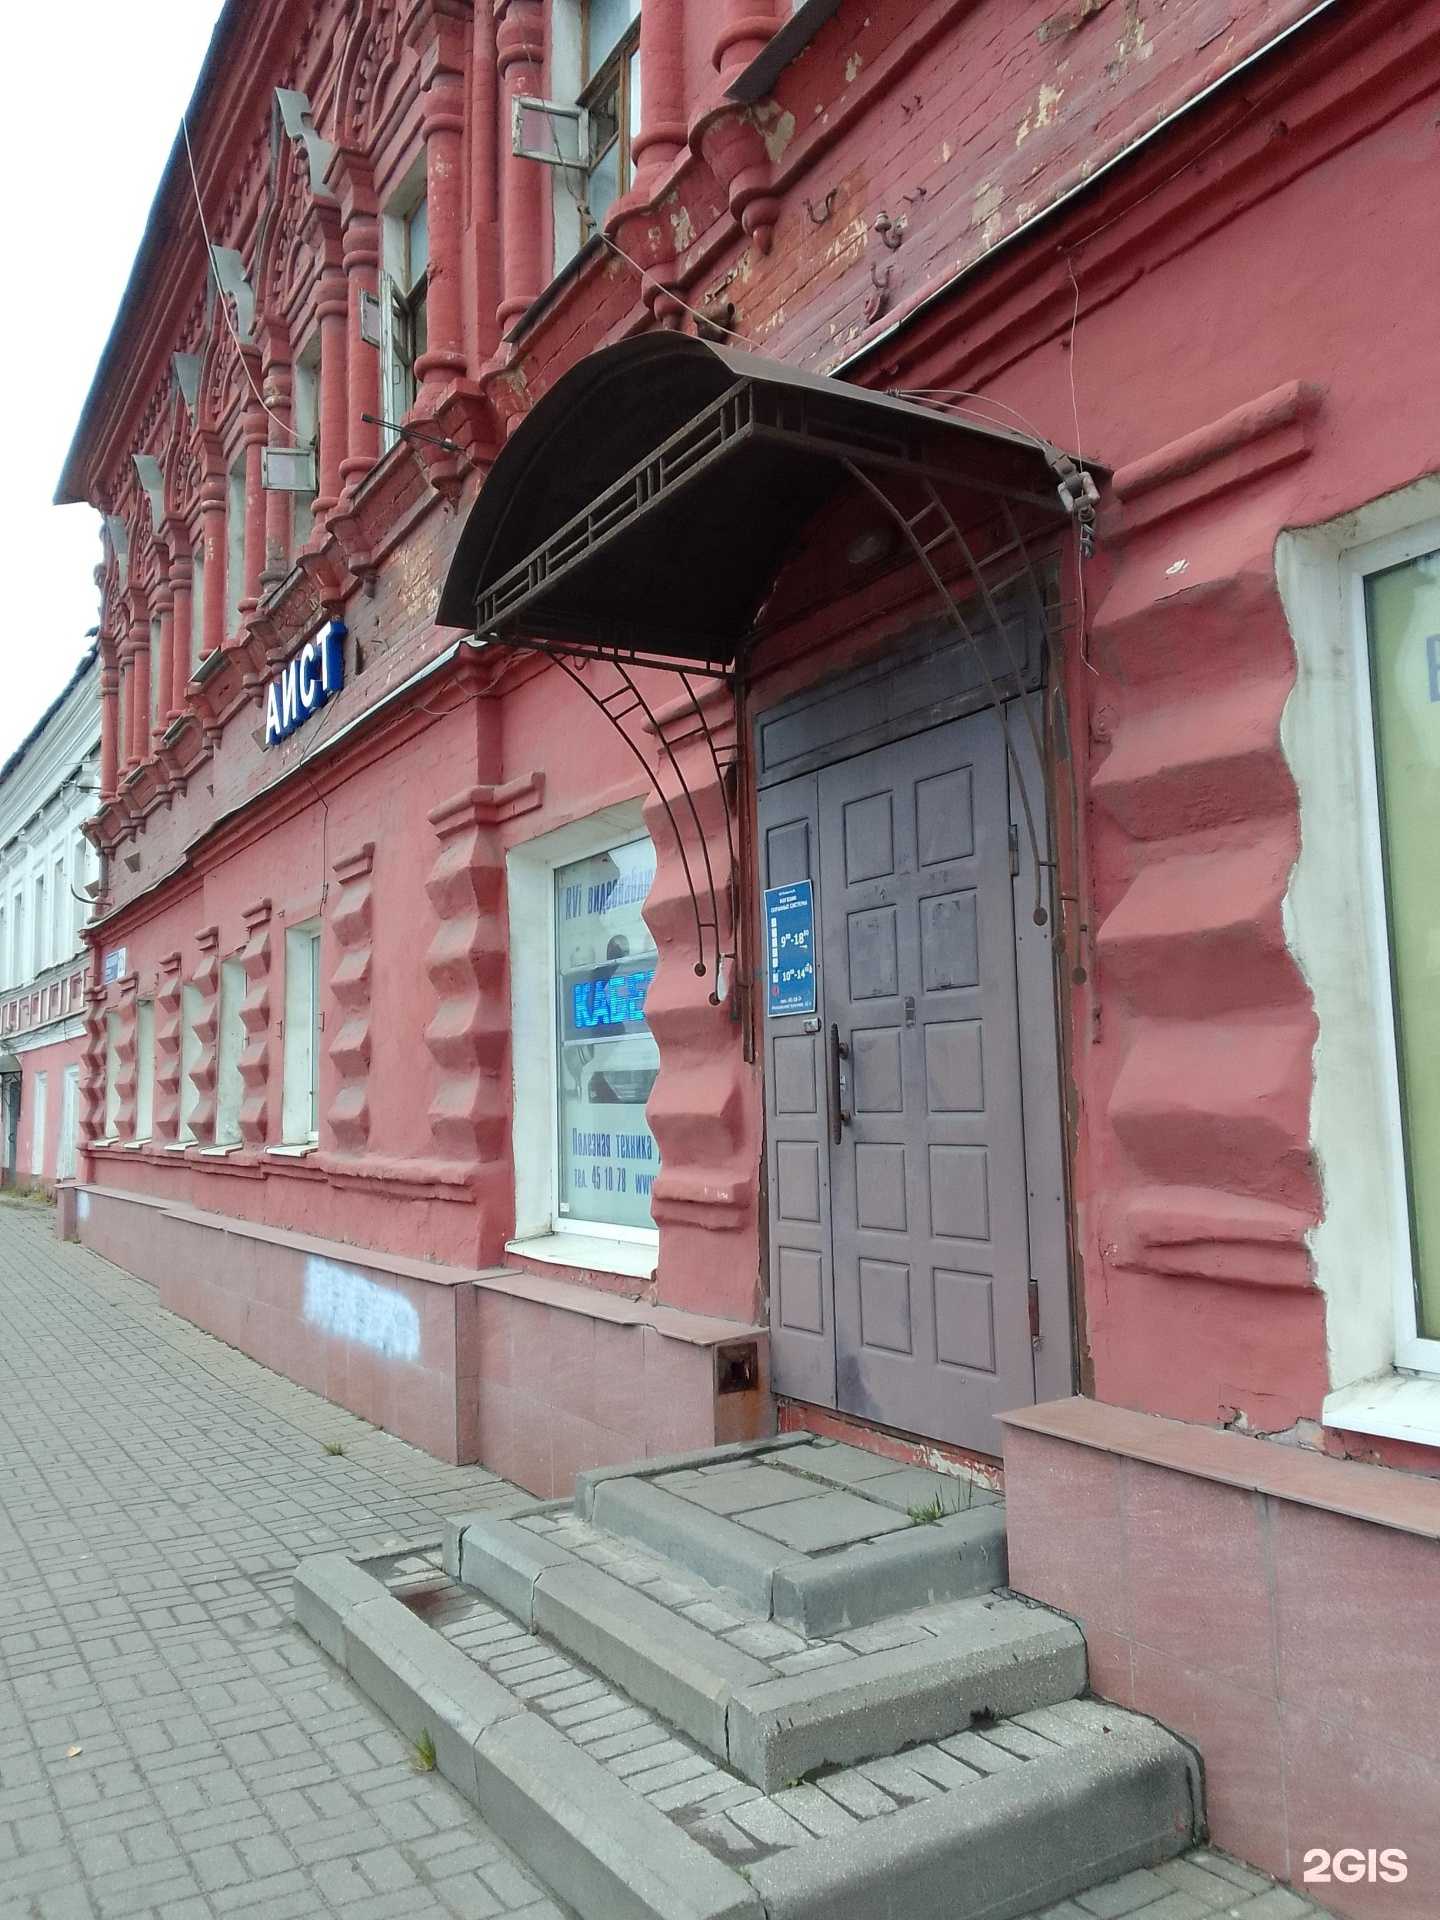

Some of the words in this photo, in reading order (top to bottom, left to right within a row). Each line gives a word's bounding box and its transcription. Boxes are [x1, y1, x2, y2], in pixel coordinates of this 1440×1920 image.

[265, 620, 334, 744] АИСТ
[575, 970, 656, 1028] КАБЕ
[572, 1127, 611, 1158] Полезная
[616, 1134, 652, 1160] техника
[592, 1165, 601, 1190] 45
[605, 1166, 613, 1191] 10
[617, 1167, 626, 1192] 78
